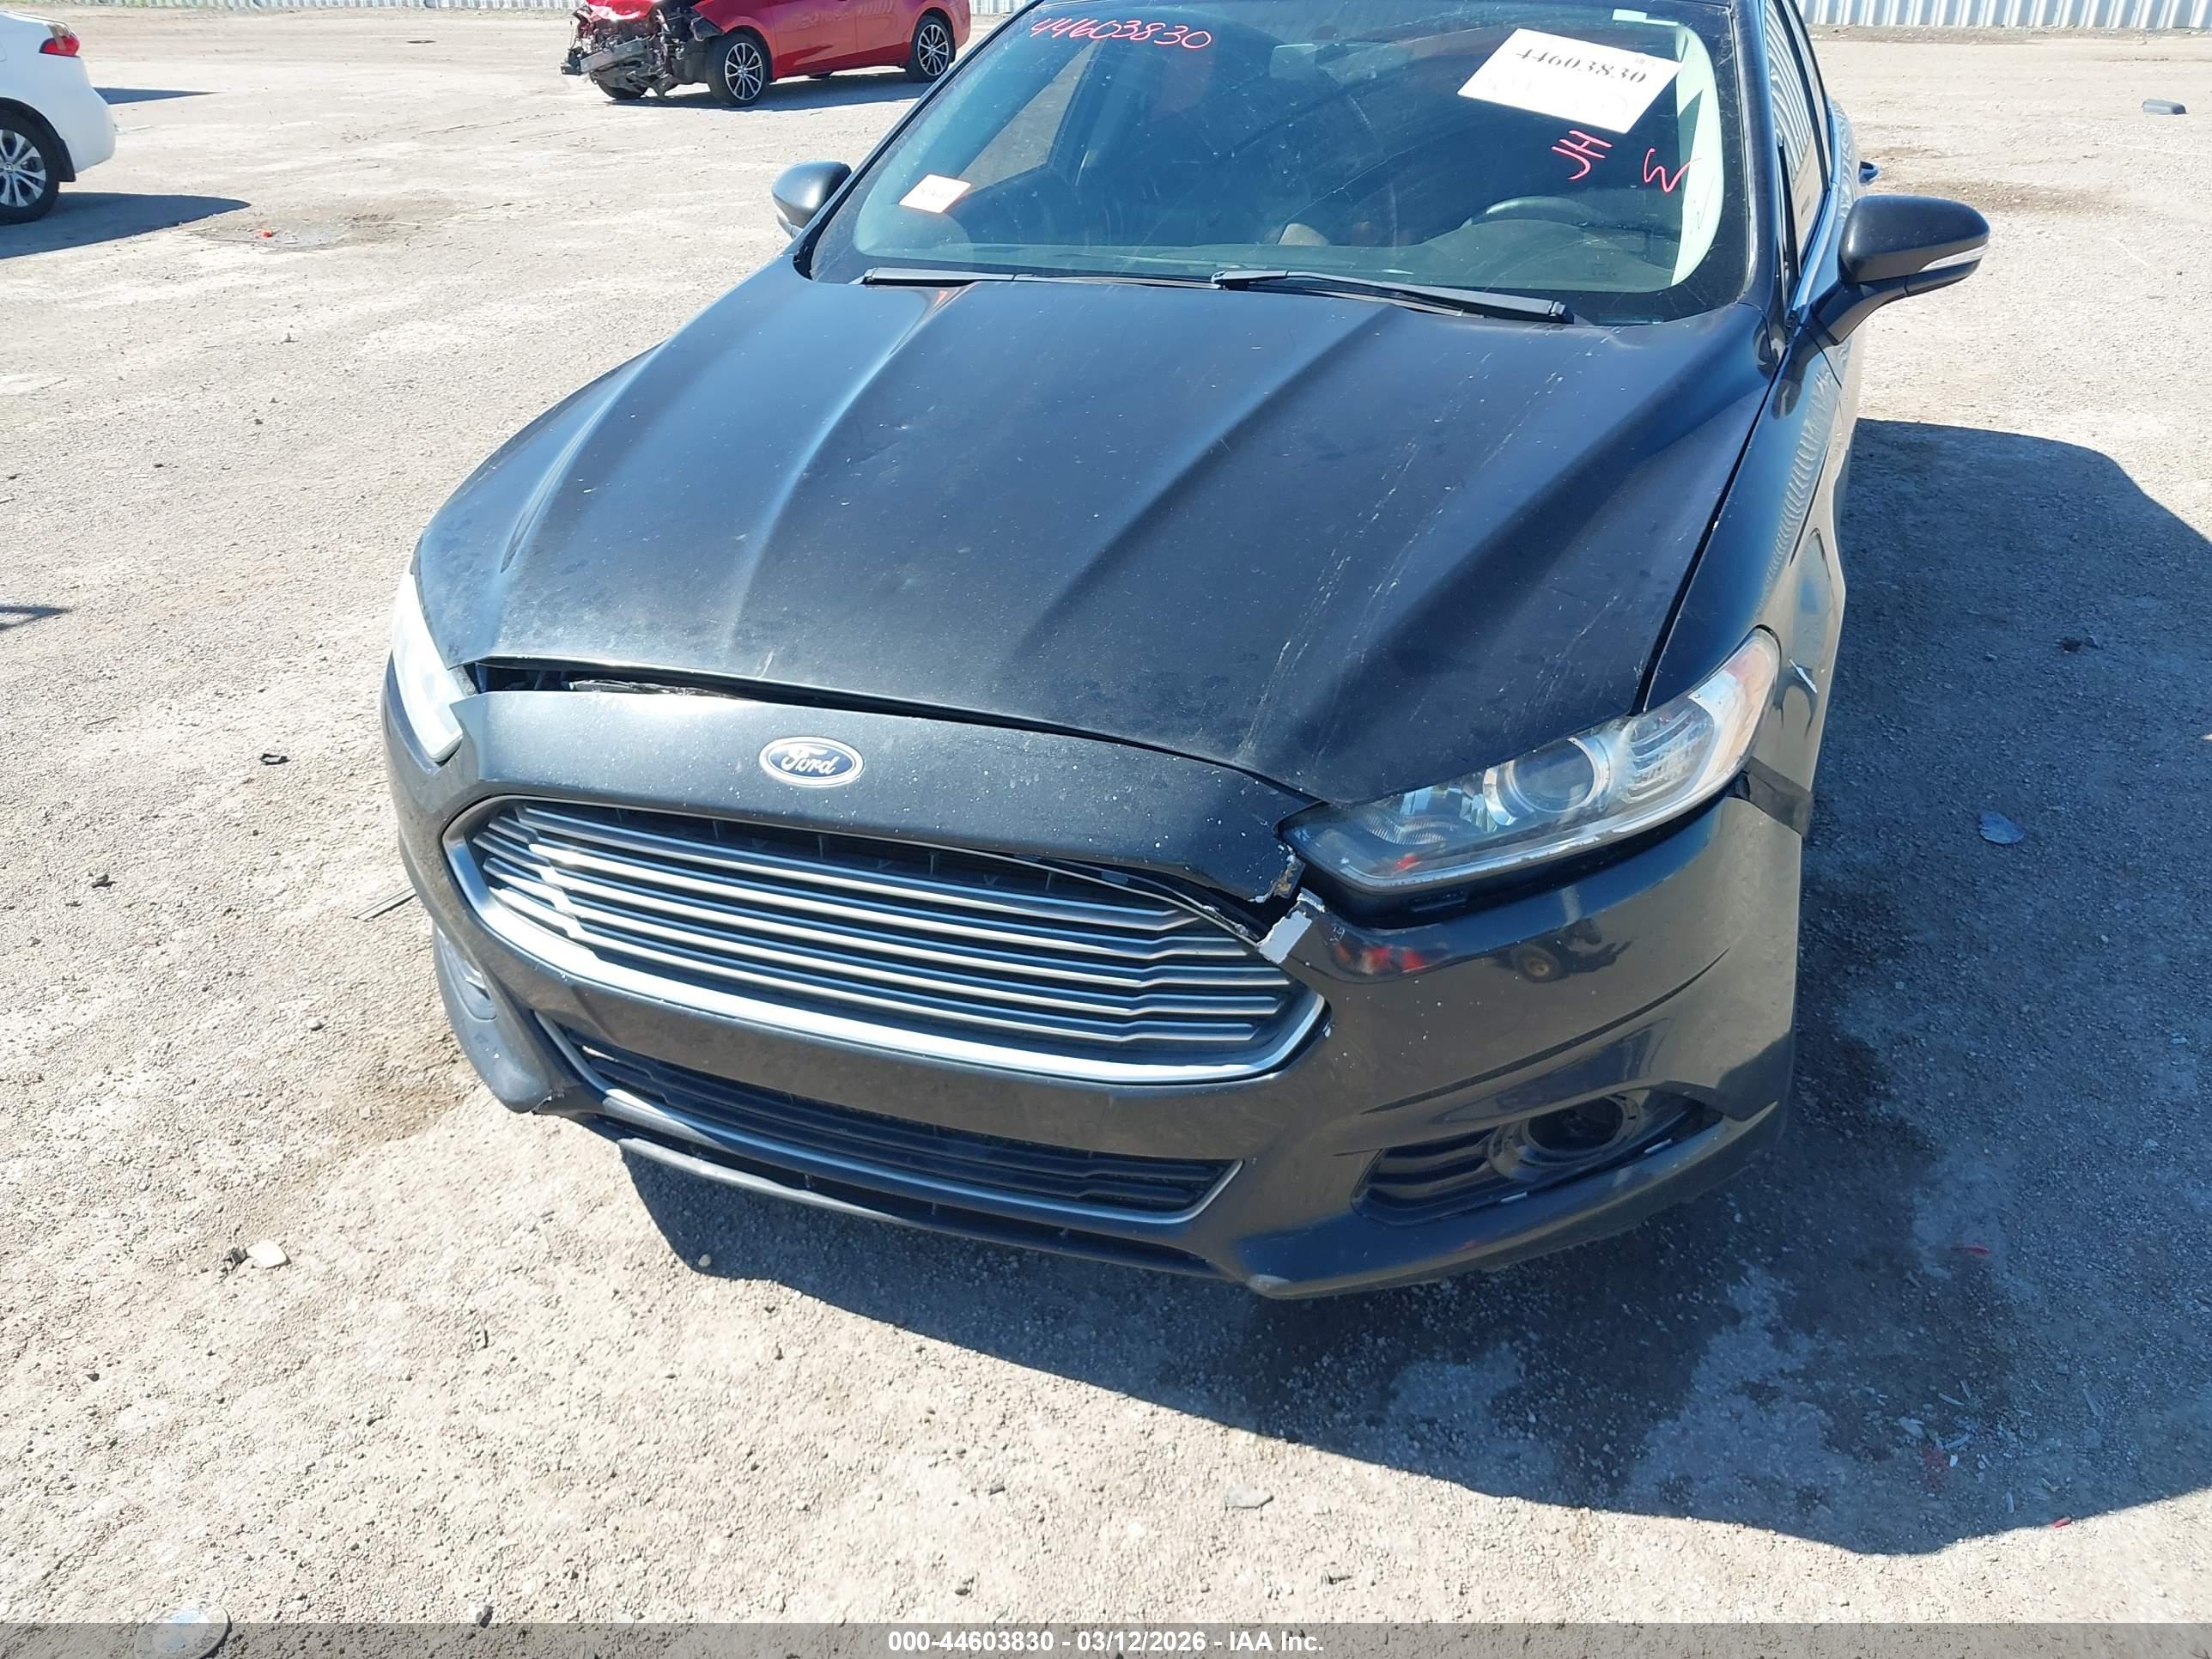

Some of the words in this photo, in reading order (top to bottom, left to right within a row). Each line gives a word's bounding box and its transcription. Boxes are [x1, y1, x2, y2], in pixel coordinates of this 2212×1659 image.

[1030, 17, 1212, 49] 44603830
[1516, 47, 1647, 84] 44603830
[780, 744, 841, 775] Ford
